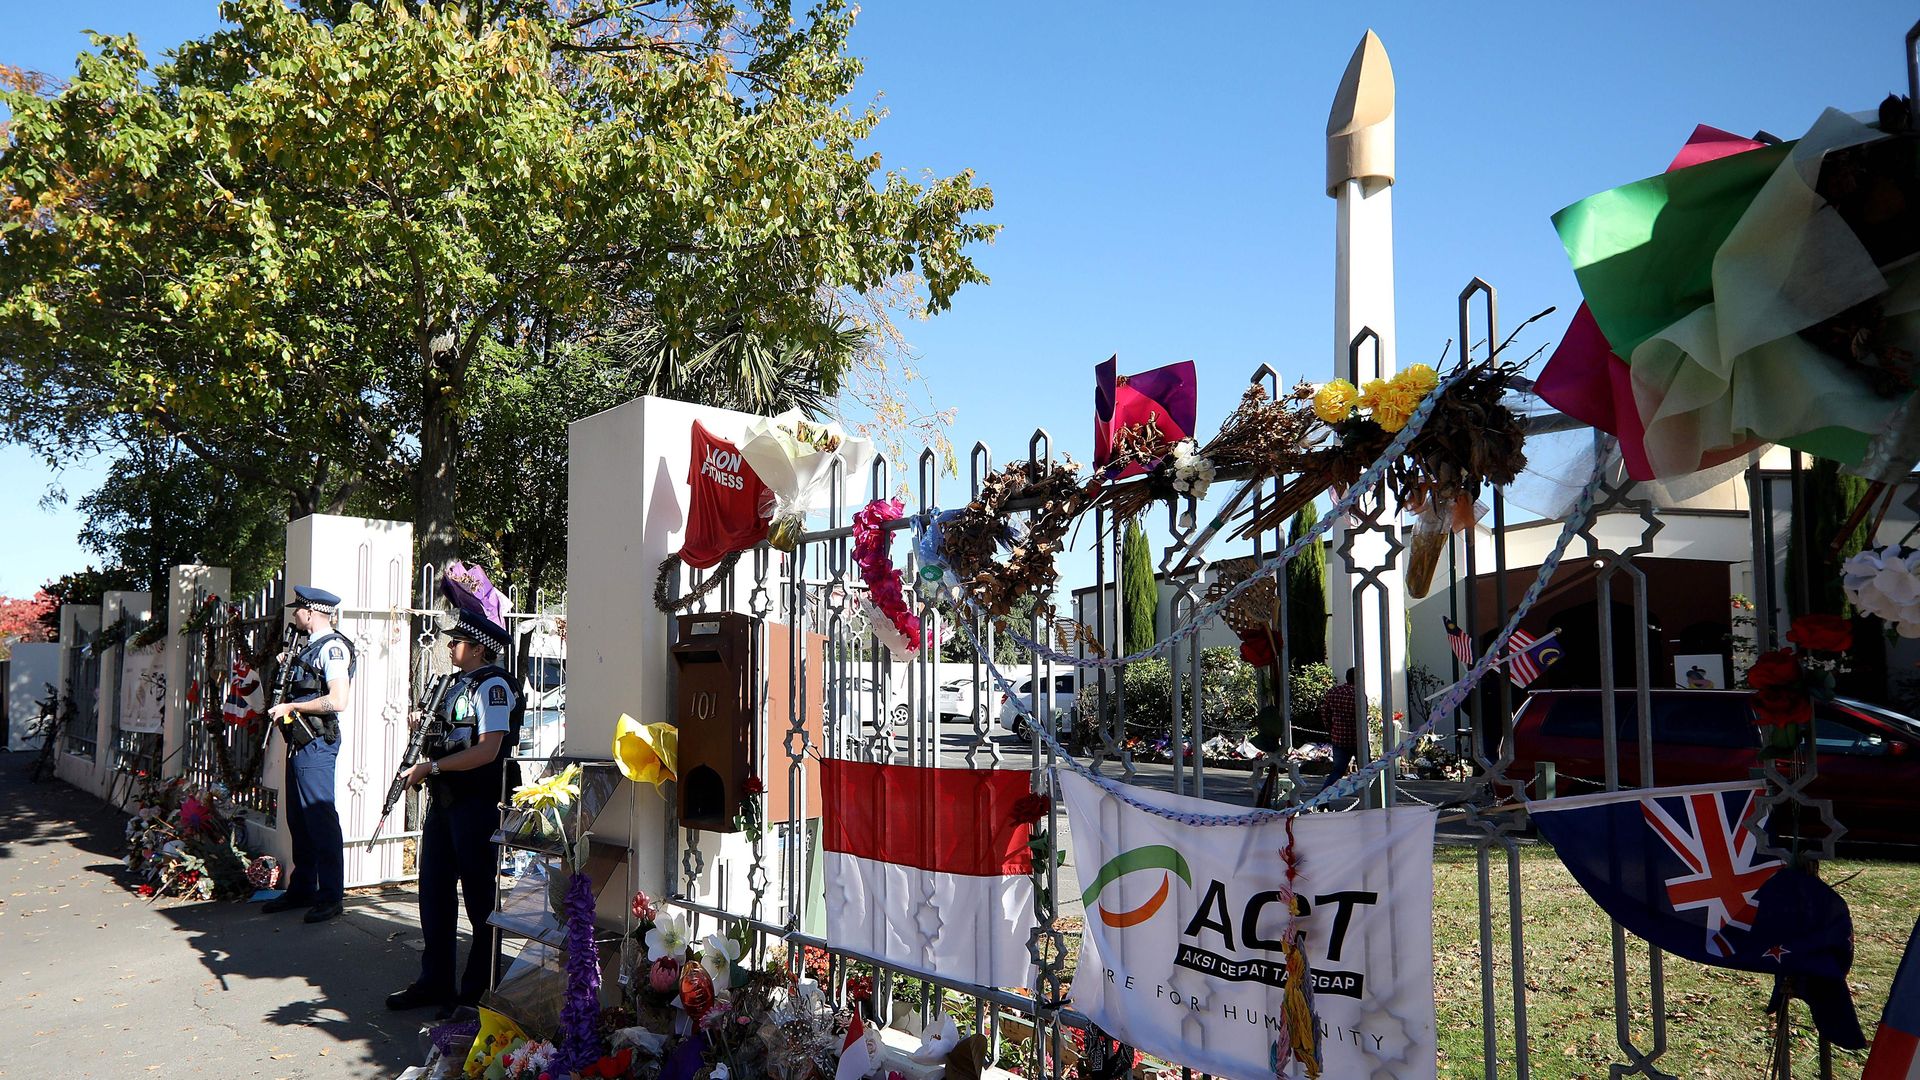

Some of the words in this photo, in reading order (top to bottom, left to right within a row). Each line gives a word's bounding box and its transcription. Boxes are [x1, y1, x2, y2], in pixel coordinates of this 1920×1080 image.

[706, 443, 743, 473] LION
[690, 690, 717, 720] 101
[1184, 878, 1379, 962] ACT
[1182, 950, 1216, 970] AKSI
[1219, 962, 1268, 977] CEPAT
[1273, 967, 1355, 990] TAGGAP
[1156, 984, 1201, 1012] FOR
[1223, 1004, 1384, 1050] HUMNITY
